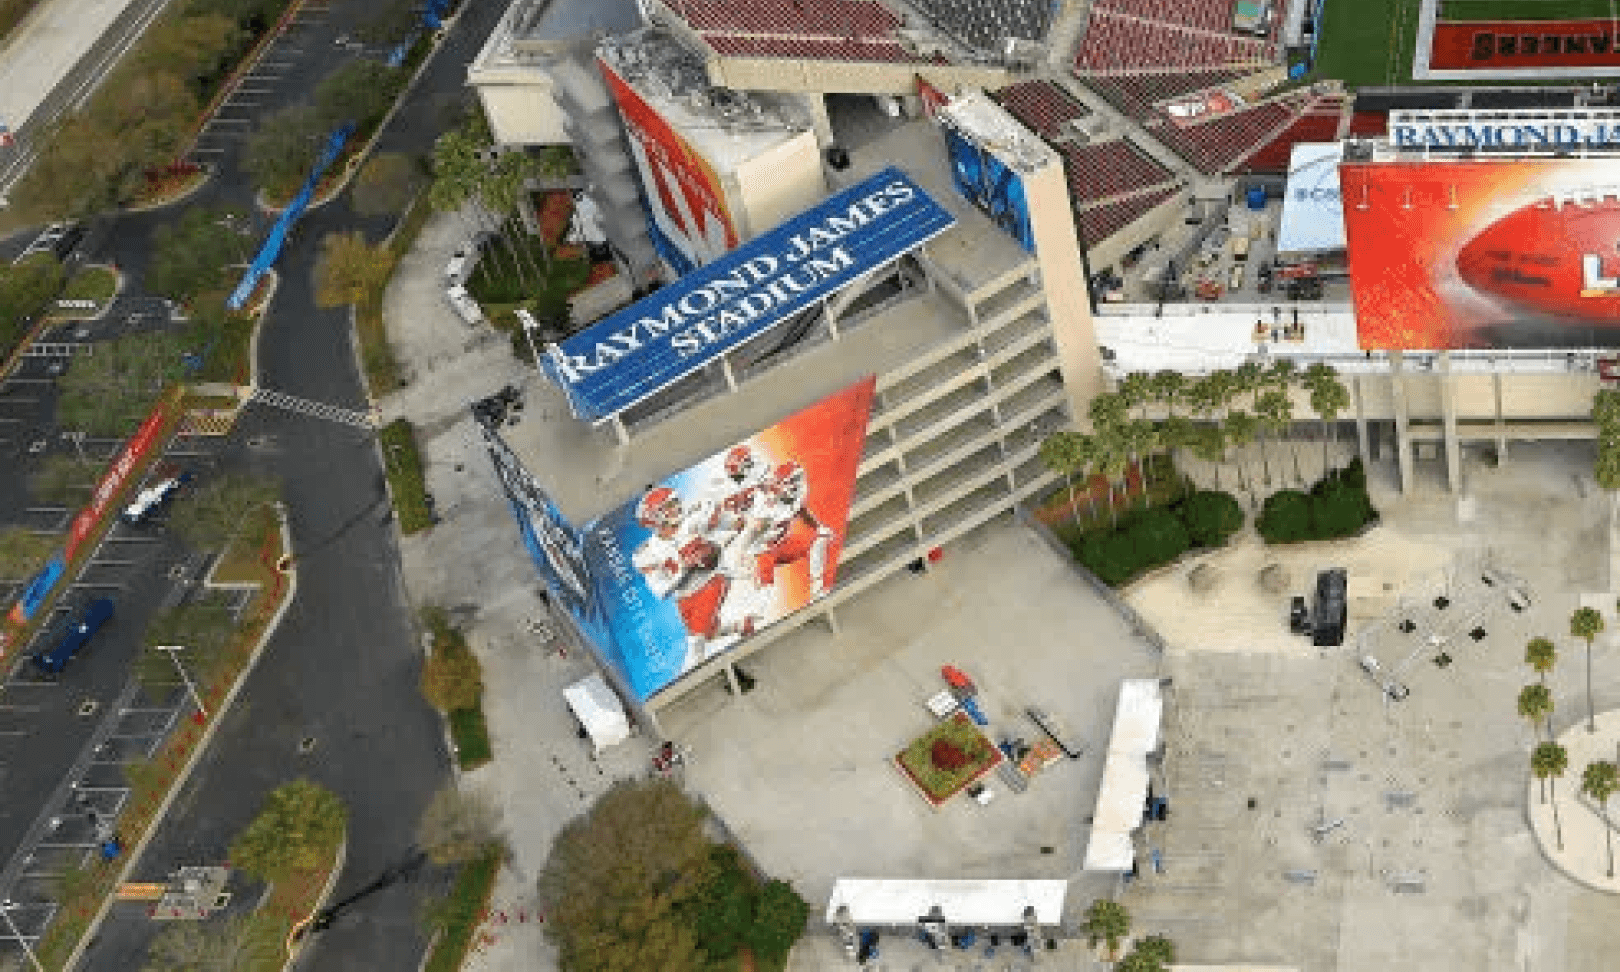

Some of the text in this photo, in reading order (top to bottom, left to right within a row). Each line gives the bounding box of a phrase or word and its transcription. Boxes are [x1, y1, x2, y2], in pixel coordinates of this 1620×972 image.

[1396, 124, 1578, 147] RAYMOND
[559, 180, 913, 383] RAYMOND JAMES
[671, 246, 853, 357] STADIUM
